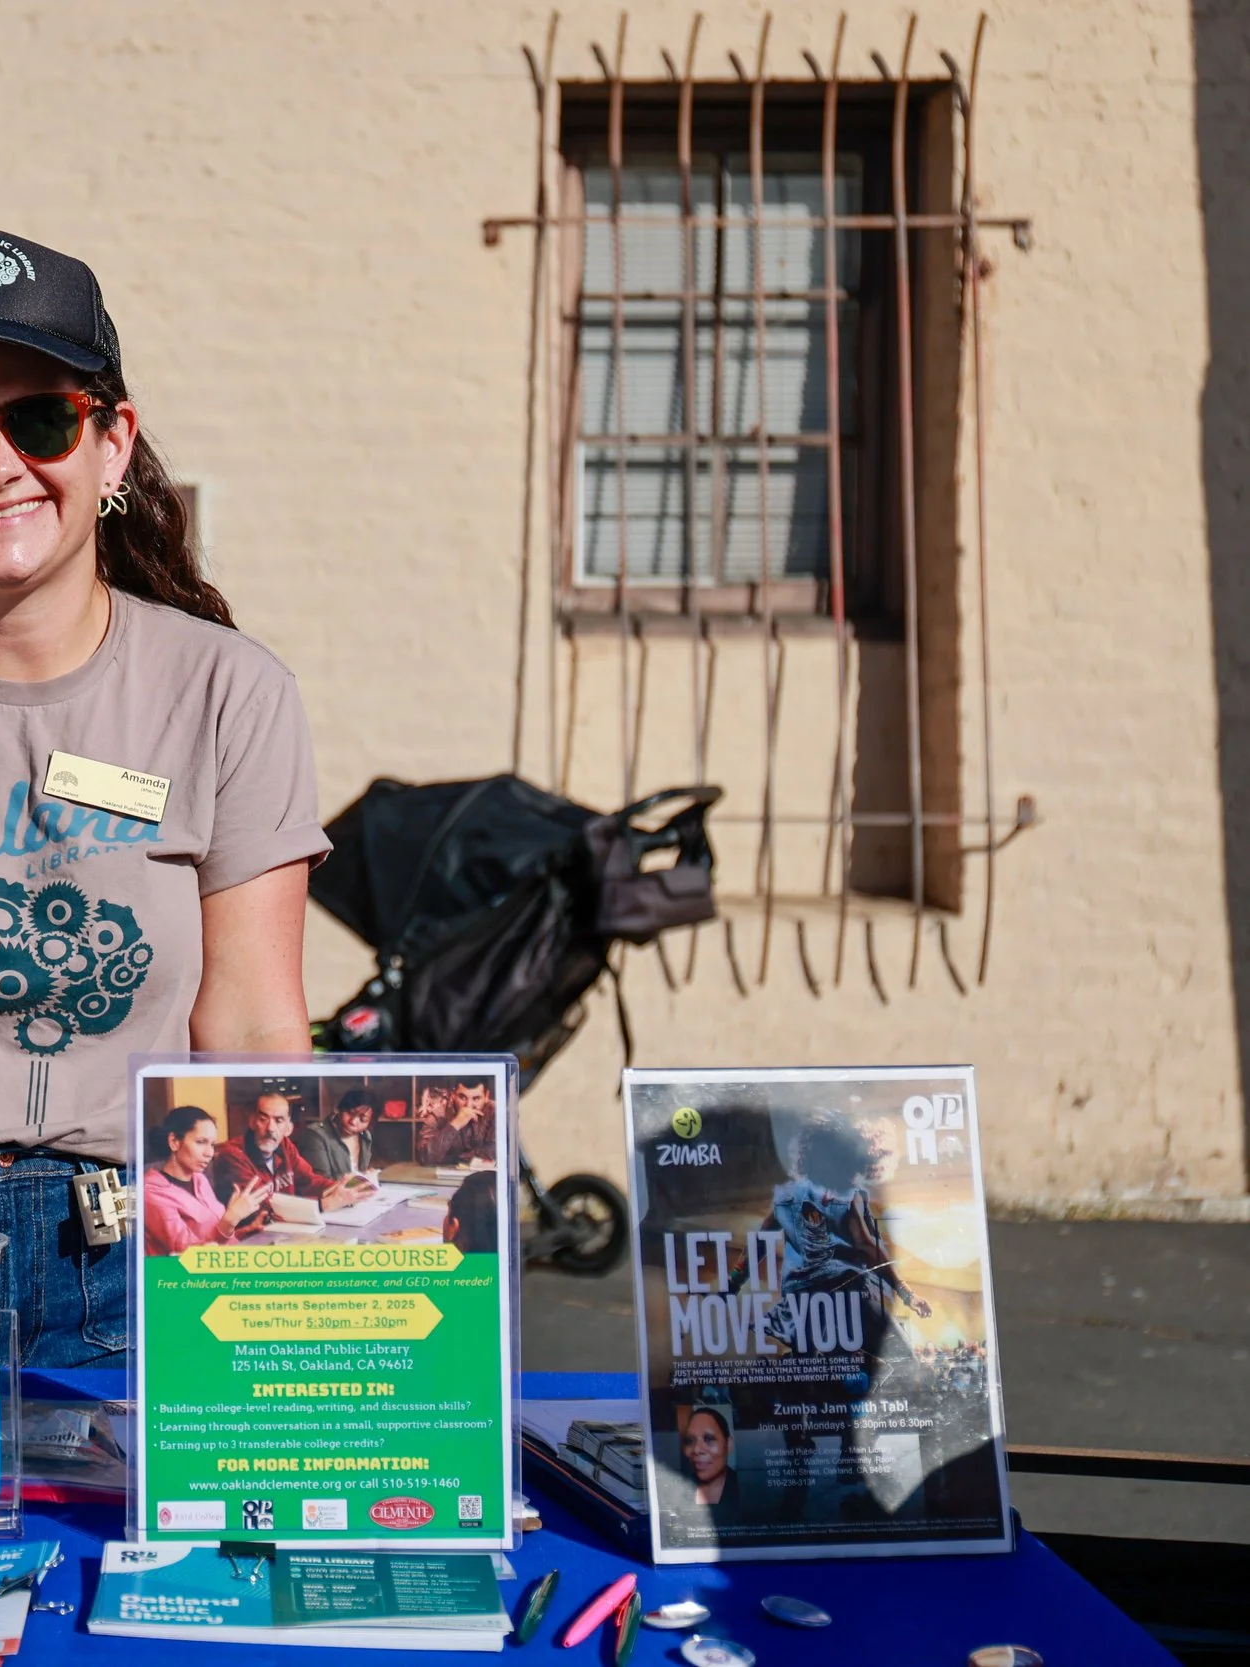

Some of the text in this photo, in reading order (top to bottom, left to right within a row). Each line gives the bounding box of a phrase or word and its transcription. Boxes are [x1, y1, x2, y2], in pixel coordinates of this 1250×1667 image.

[12, 248, 36, 282] LIBRARY
[120, 771, 166, 790] Amanda
[102, 800, 123, 810] Oakland
[26, 845, 132, 880] LIBRA
[656, 1143, 722, 1167] ZUMBA
[196, 1249, 448, 1269] FREE COLLEGE COURSE
[664, 1230, 784, 1293] LET IT
[157, 1276, 494, 1290] Free childcare, free transporation assistance, and GED not needed!
[228, 1299, 416, 1313] Class starts September 2, 2025
[242, 1317, 302, 1329] Tues/Thur
[306, 1316, 352, 1329] 5:30pm
[362, 1316, 408, 1329] 7:30pm
[669, 1291, 864, 1356] MOVE YOU
[234, 1343, 410, 1357] Main Oakland Public Library
[232, 1358, 414, 1372] 125 14th St, Oakland, CA 94612
[673, 1361, 696, 1369] THERE
[850, 1356, 865, 1364] ARE
[252, 1382, 395, 1397] INTERESTED IN:
[158, 1401, 472, 1415] Building college-level reading, writing, and discussion skills?
[774, 1400, 909, 1416] Zumba Jam with Tab!
[159, 1422, 207, 1434] Learning
[208, 1421, 251, 1433] through
[252, 1422, 320, 1431] conversation
[343, 1420, 374, 1430] small,
[376, 1421, 431, 1432] supportive
[433, 1419, 493, 1429] classroom?
[757, 1423, 776, 1433] Join
[805, 1420, 846, 1432] Mondays
[854, 1419, 887, 1431] 5:30pm
[888, 1419, 898, 1428] to
[899, 1417, 934, 1429] 6:30pm
[160, 1438, 385, 1452] Earning up to 3 transferable college credits?
[217, 1458, 430, 1472] FOR MORE INFORMATION:
[189, 1477, 460, 1492] www.oaklandclemente.org or call 510-519-1460
[371, 1506, 432, 1520] CLEMENTE
[289, 1556, 375, 1566] MAIN LIBRARY
[120, 1594, 240, 1606] Oakland
[120, 1603, 209, 1614] Public
[120, 1612, 223, 1624] Library
